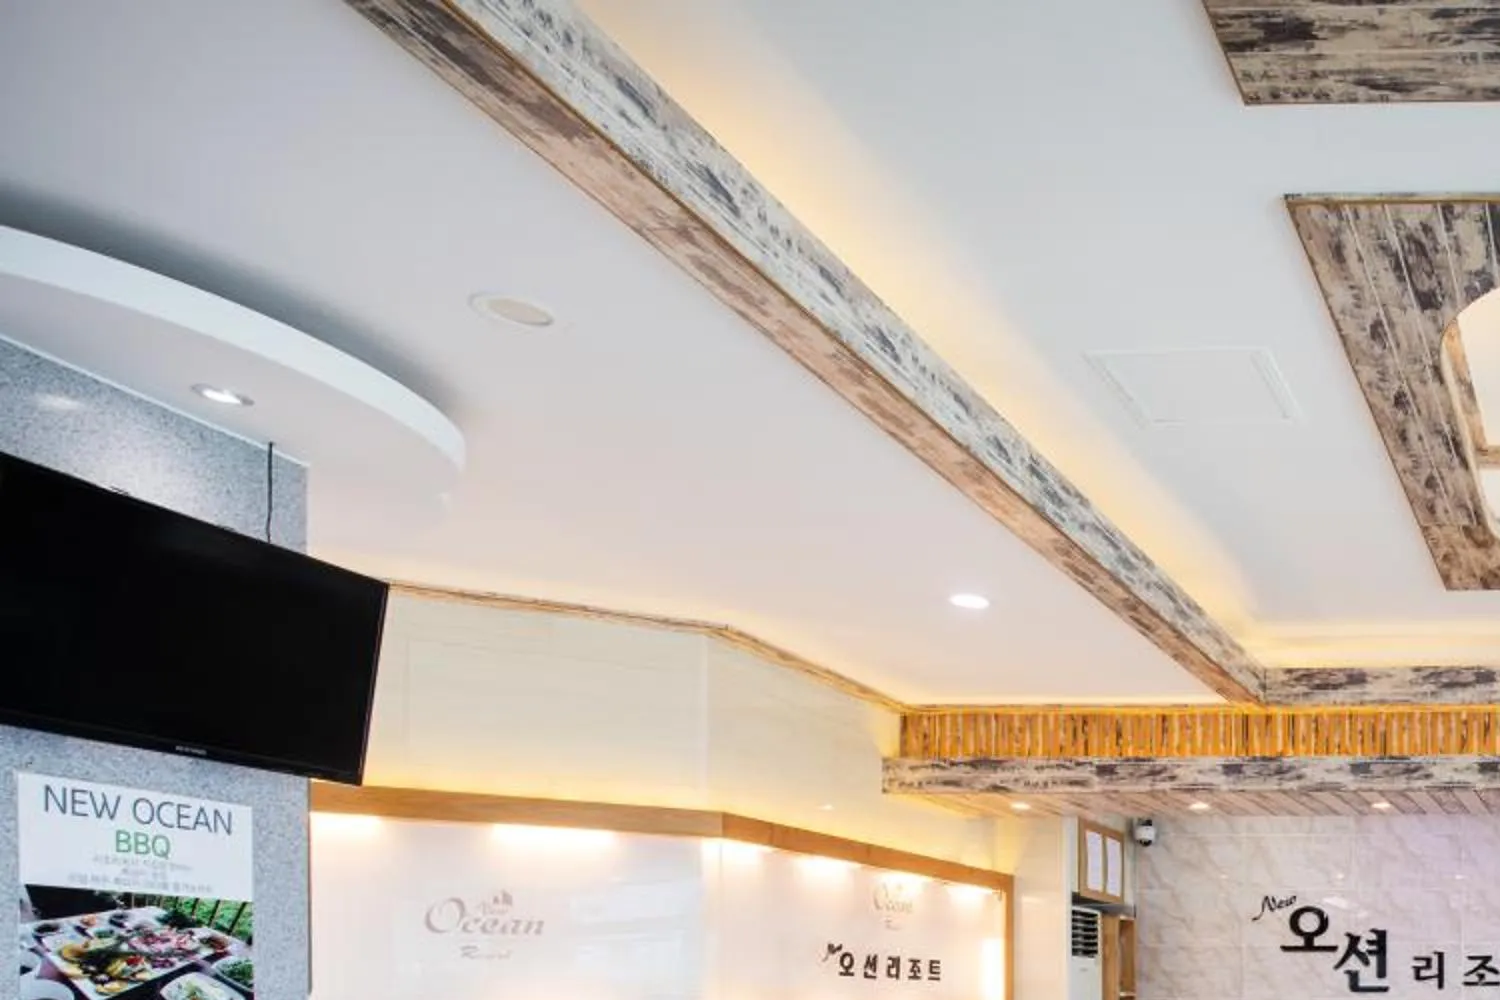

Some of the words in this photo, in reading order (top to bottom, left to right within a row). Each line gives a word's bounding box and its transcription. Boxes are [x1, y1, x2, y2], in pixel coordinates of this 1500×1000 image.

[43, 784, 121, 821] NEW
[132, 797, 233, 836] OCEAN
[115, 829, 171, 860] BBQ
[425, 897, 544, 935] Ocean
[1251, 895, 1297, 921] New
[1280, 906, 1390, 992] 오션
